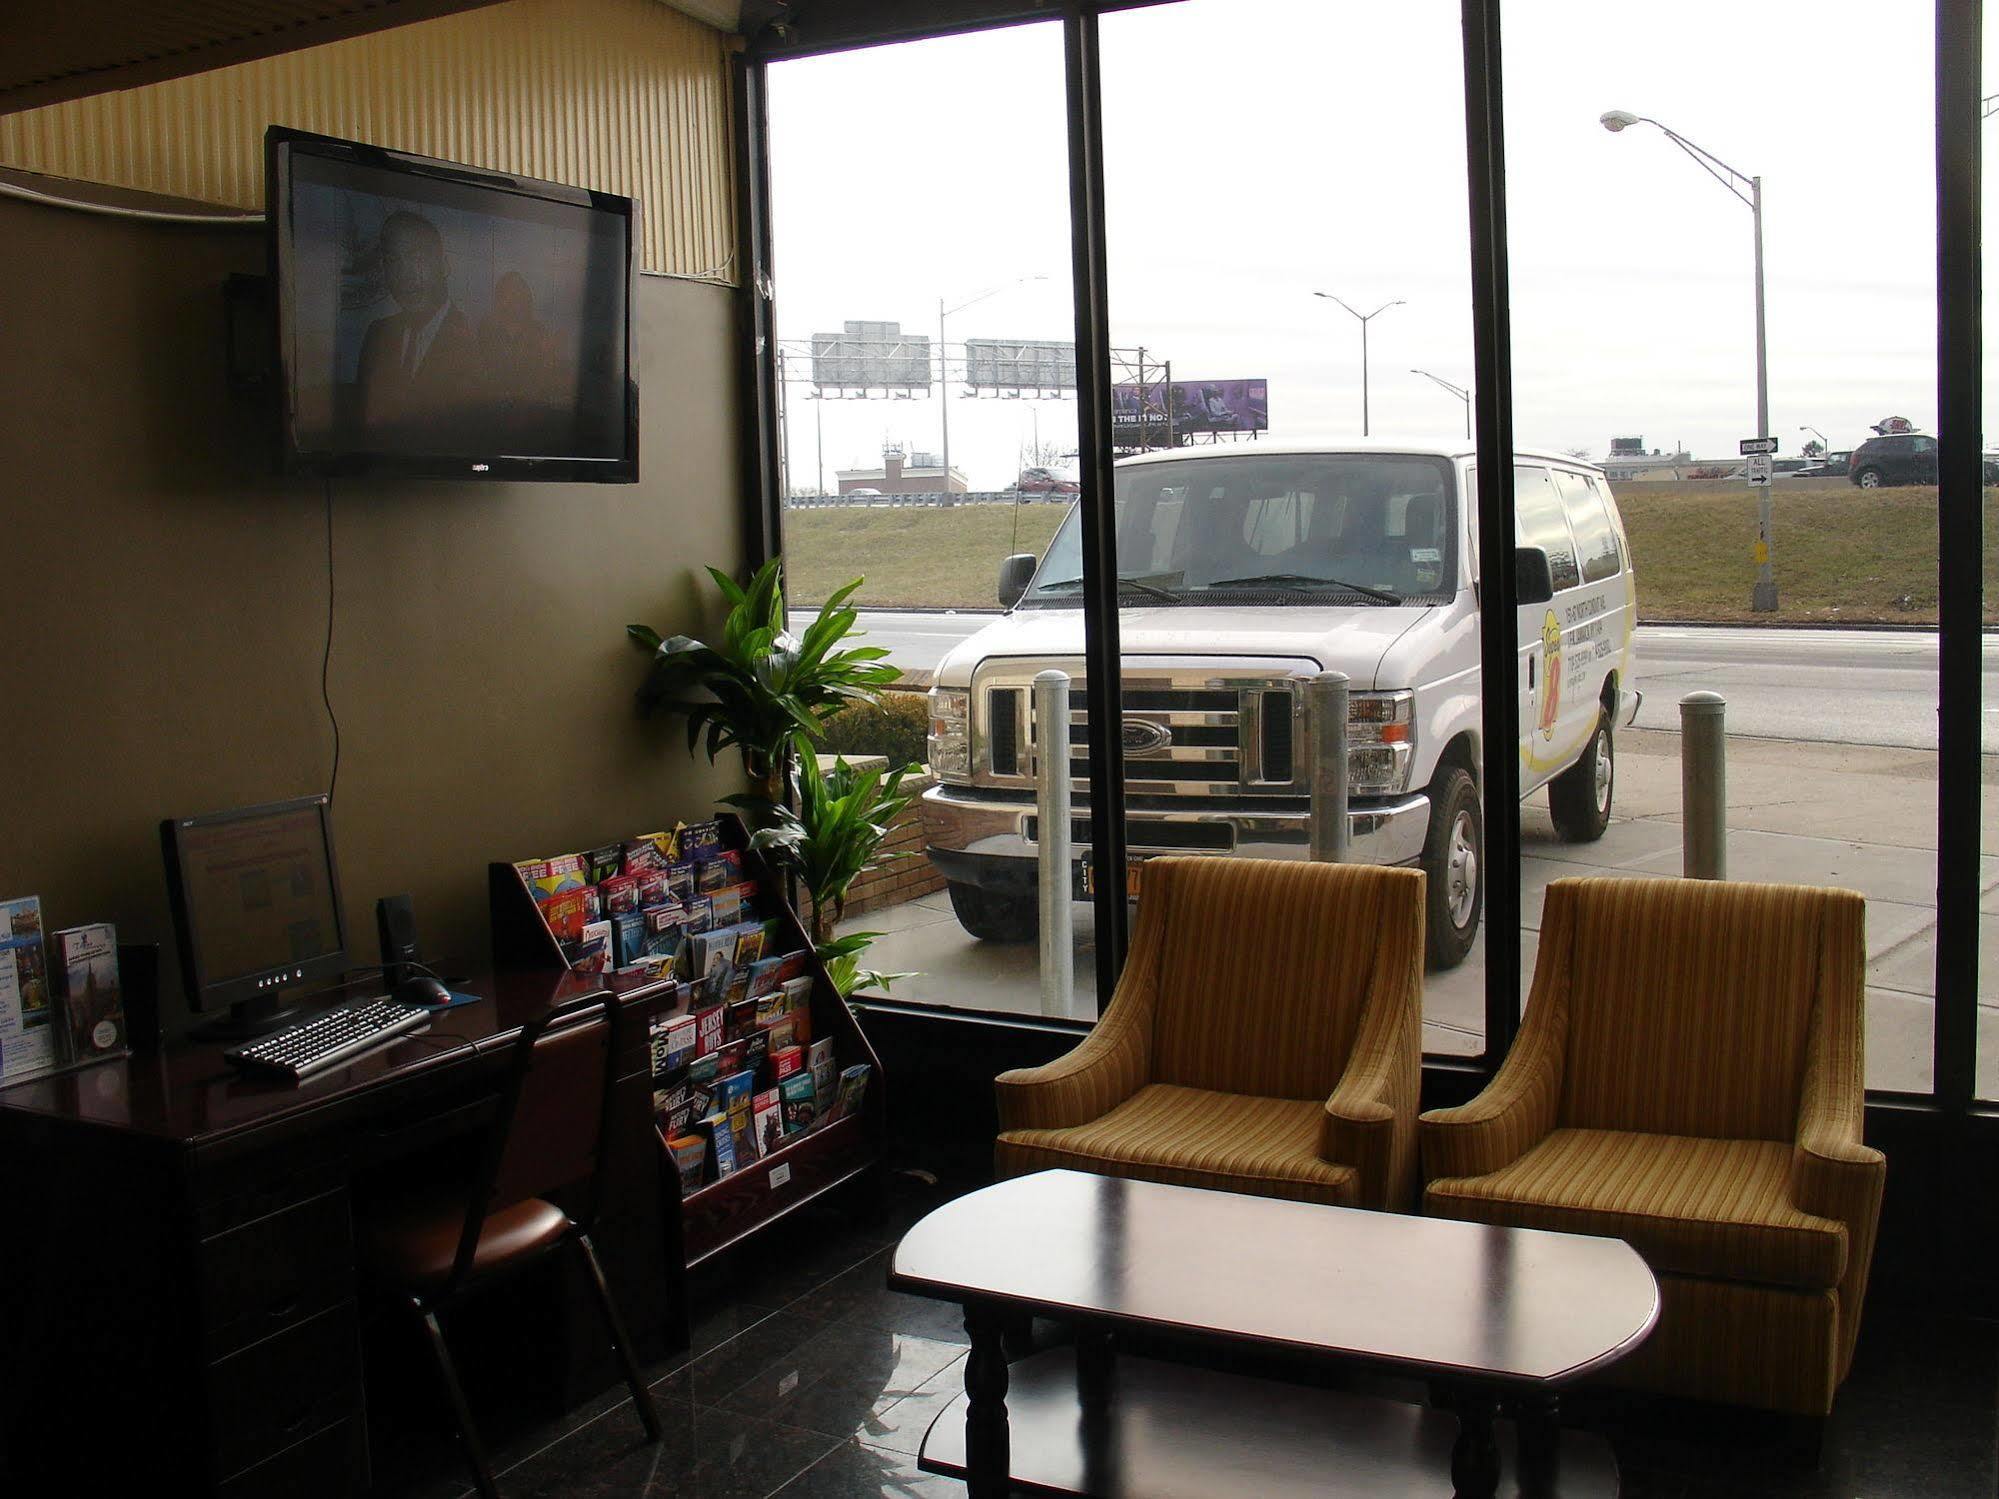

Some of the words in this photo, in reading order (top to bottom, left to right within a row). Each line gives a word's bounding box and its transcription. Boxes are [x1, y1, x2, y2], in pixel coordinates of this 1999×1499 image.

[1754, 458, 1766, 466] ALL
[1081, 860, 1089, 892] CITY
[701, 1005, 725, 1038] JERSEY
